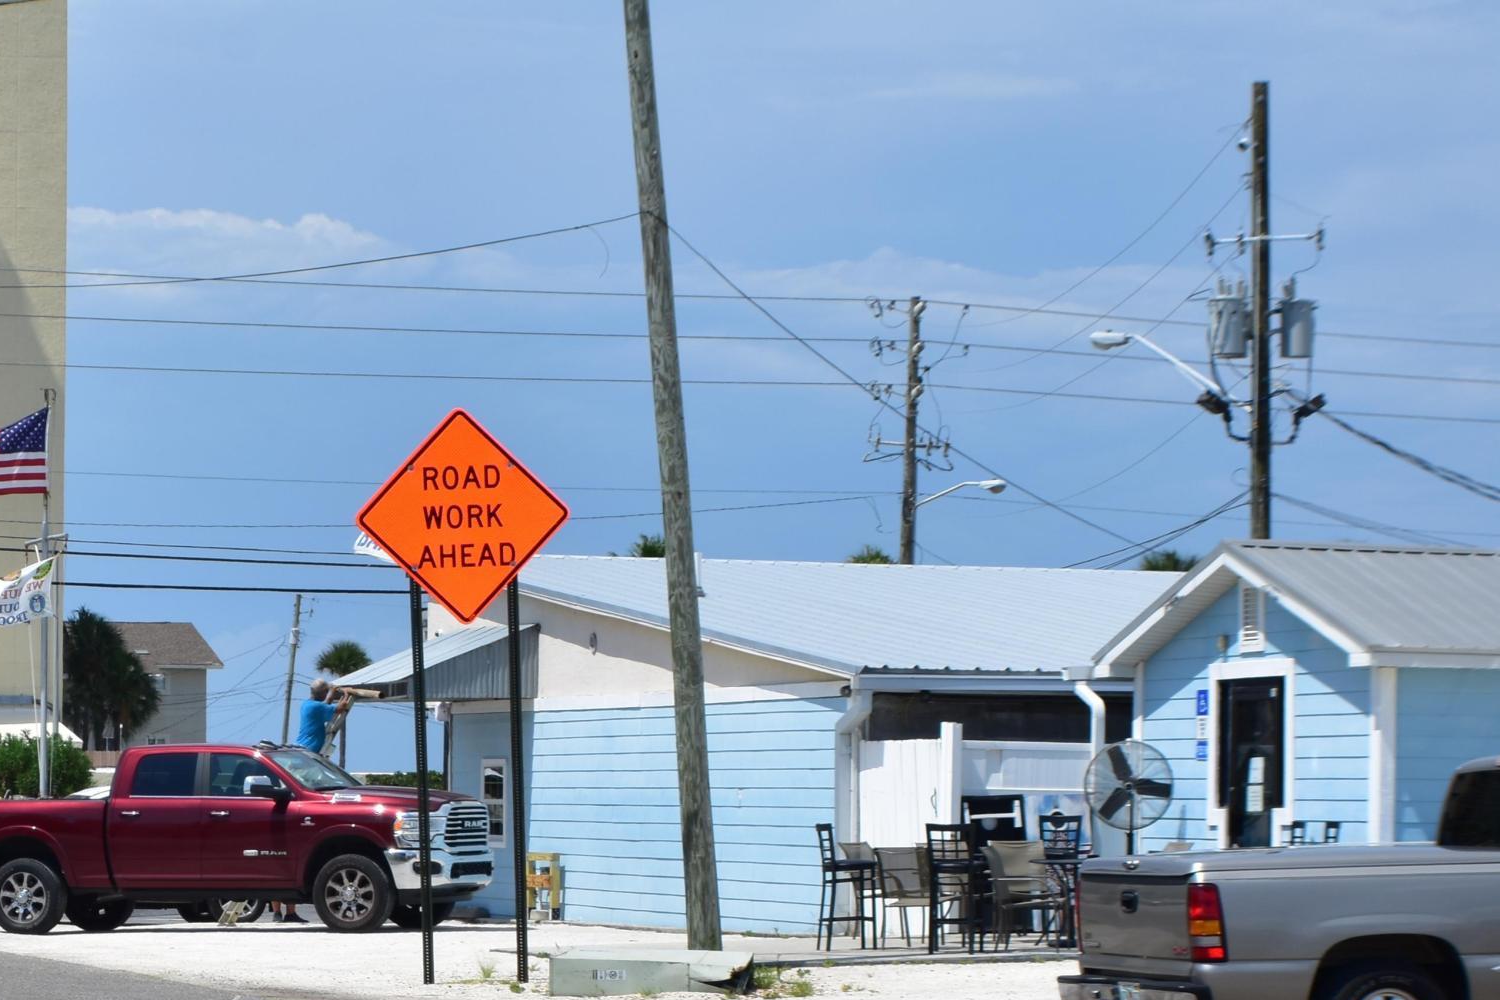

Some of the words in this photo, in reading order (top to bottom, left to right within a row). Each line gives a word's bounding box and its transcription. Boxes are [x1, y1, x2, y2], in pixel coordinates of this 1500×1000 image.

[422, 465, 501, 491] ROAD
[423, 504, 503, 529] WORK
[418, 542, 516, 569] AHEAD
